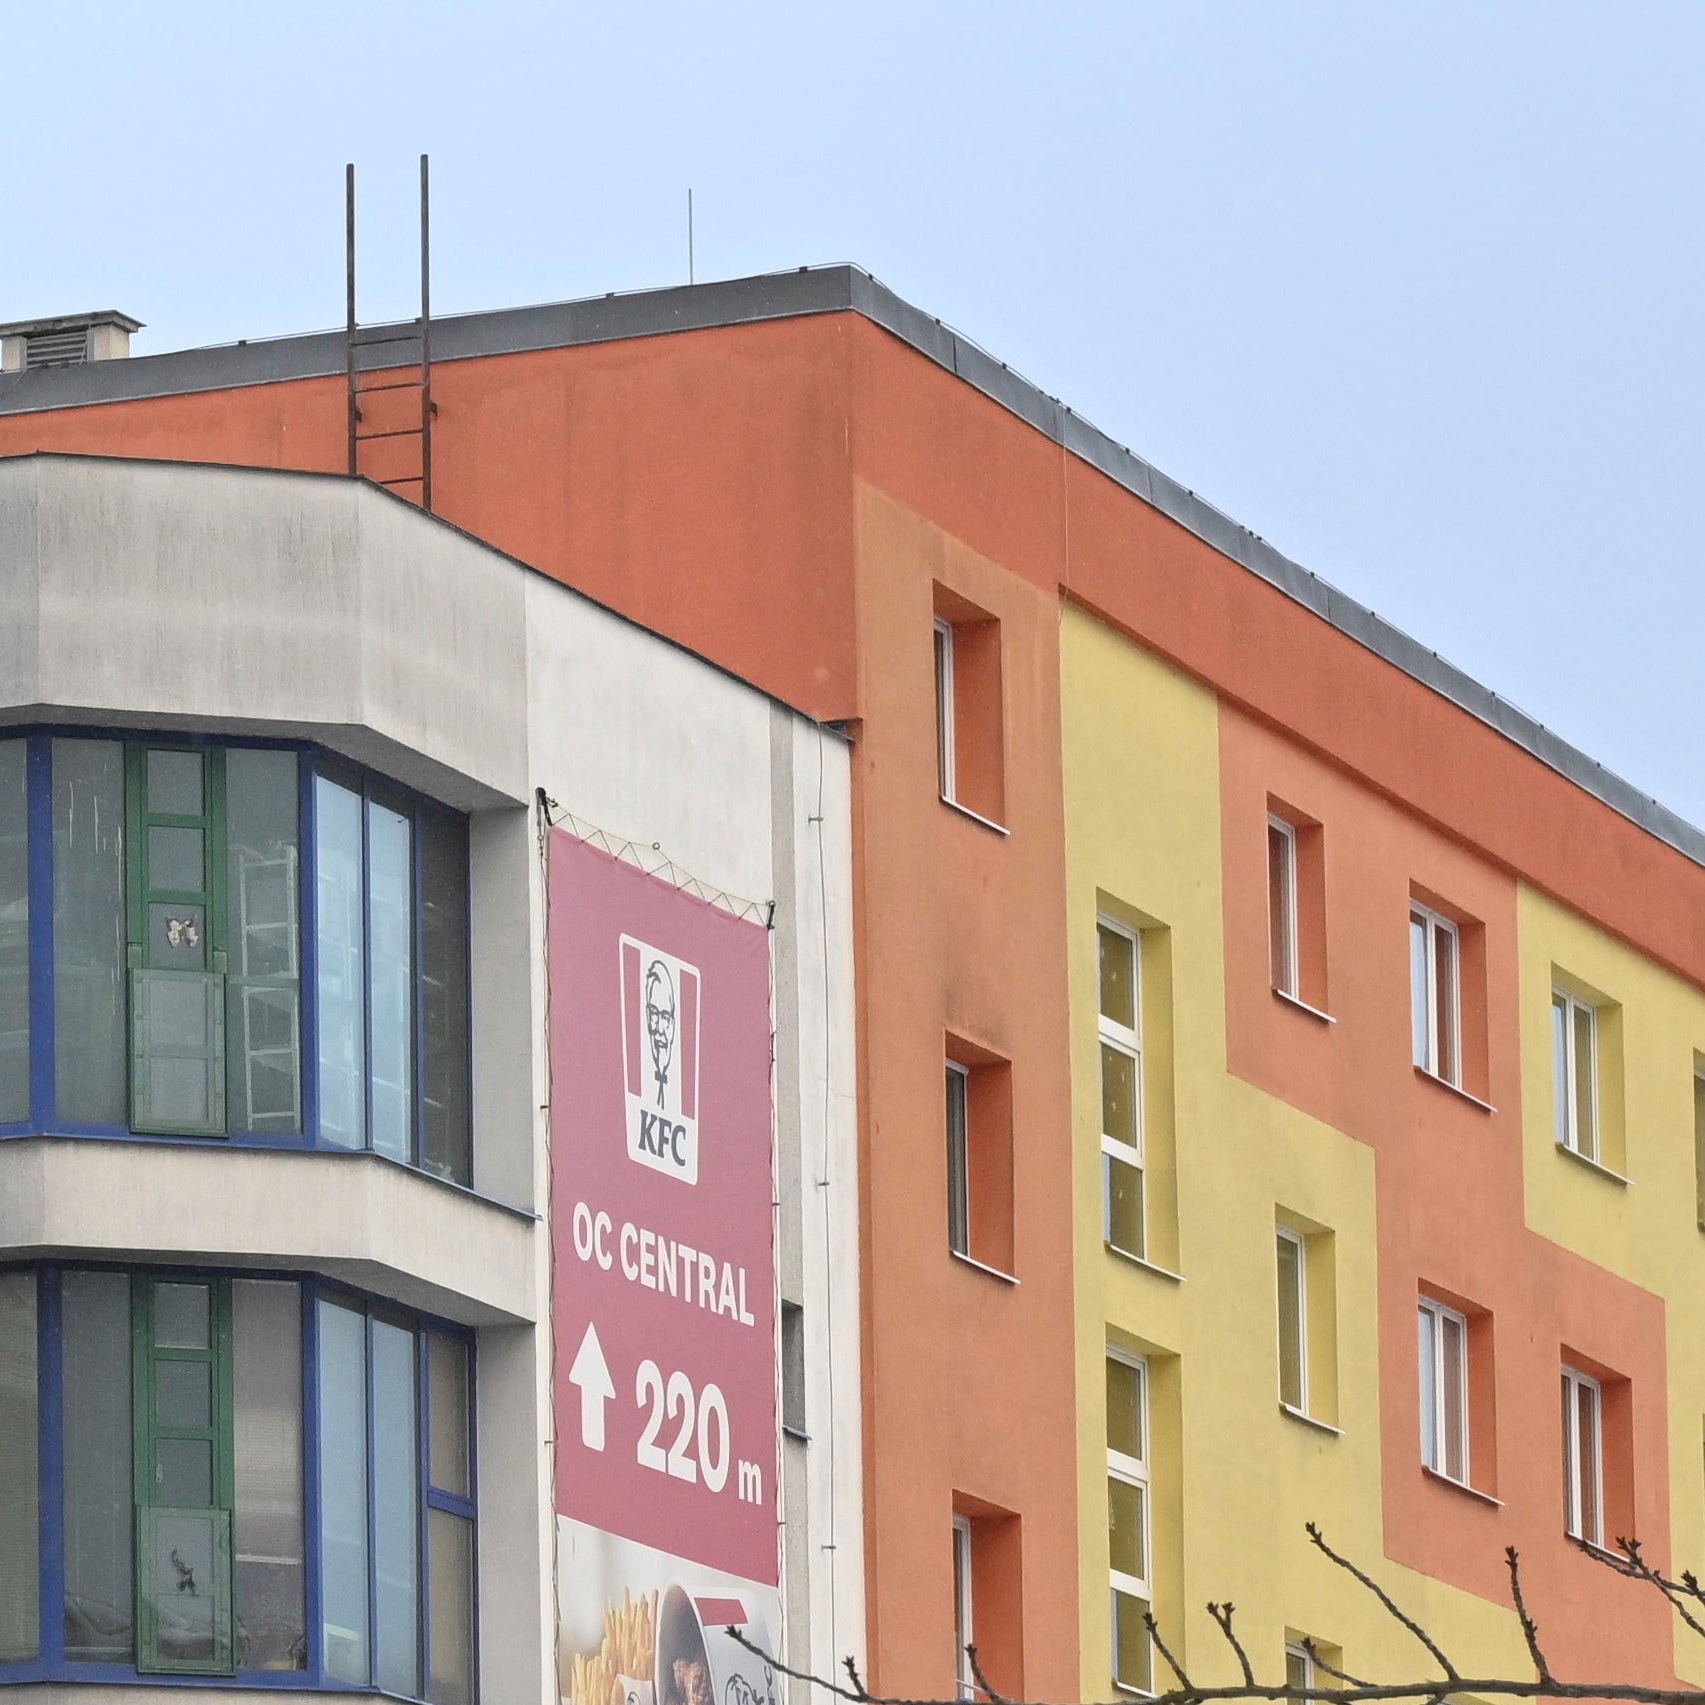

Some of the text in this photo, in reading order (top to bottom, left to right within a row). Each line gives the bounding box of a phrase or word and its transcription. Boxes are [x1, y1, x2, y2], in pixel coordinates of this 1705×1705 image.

[638, 1109, 687, 1167] KFC
[573, 1202, 755, 1327] OC CENTRAL
[635, 1359, 763, 1505] 220 m
